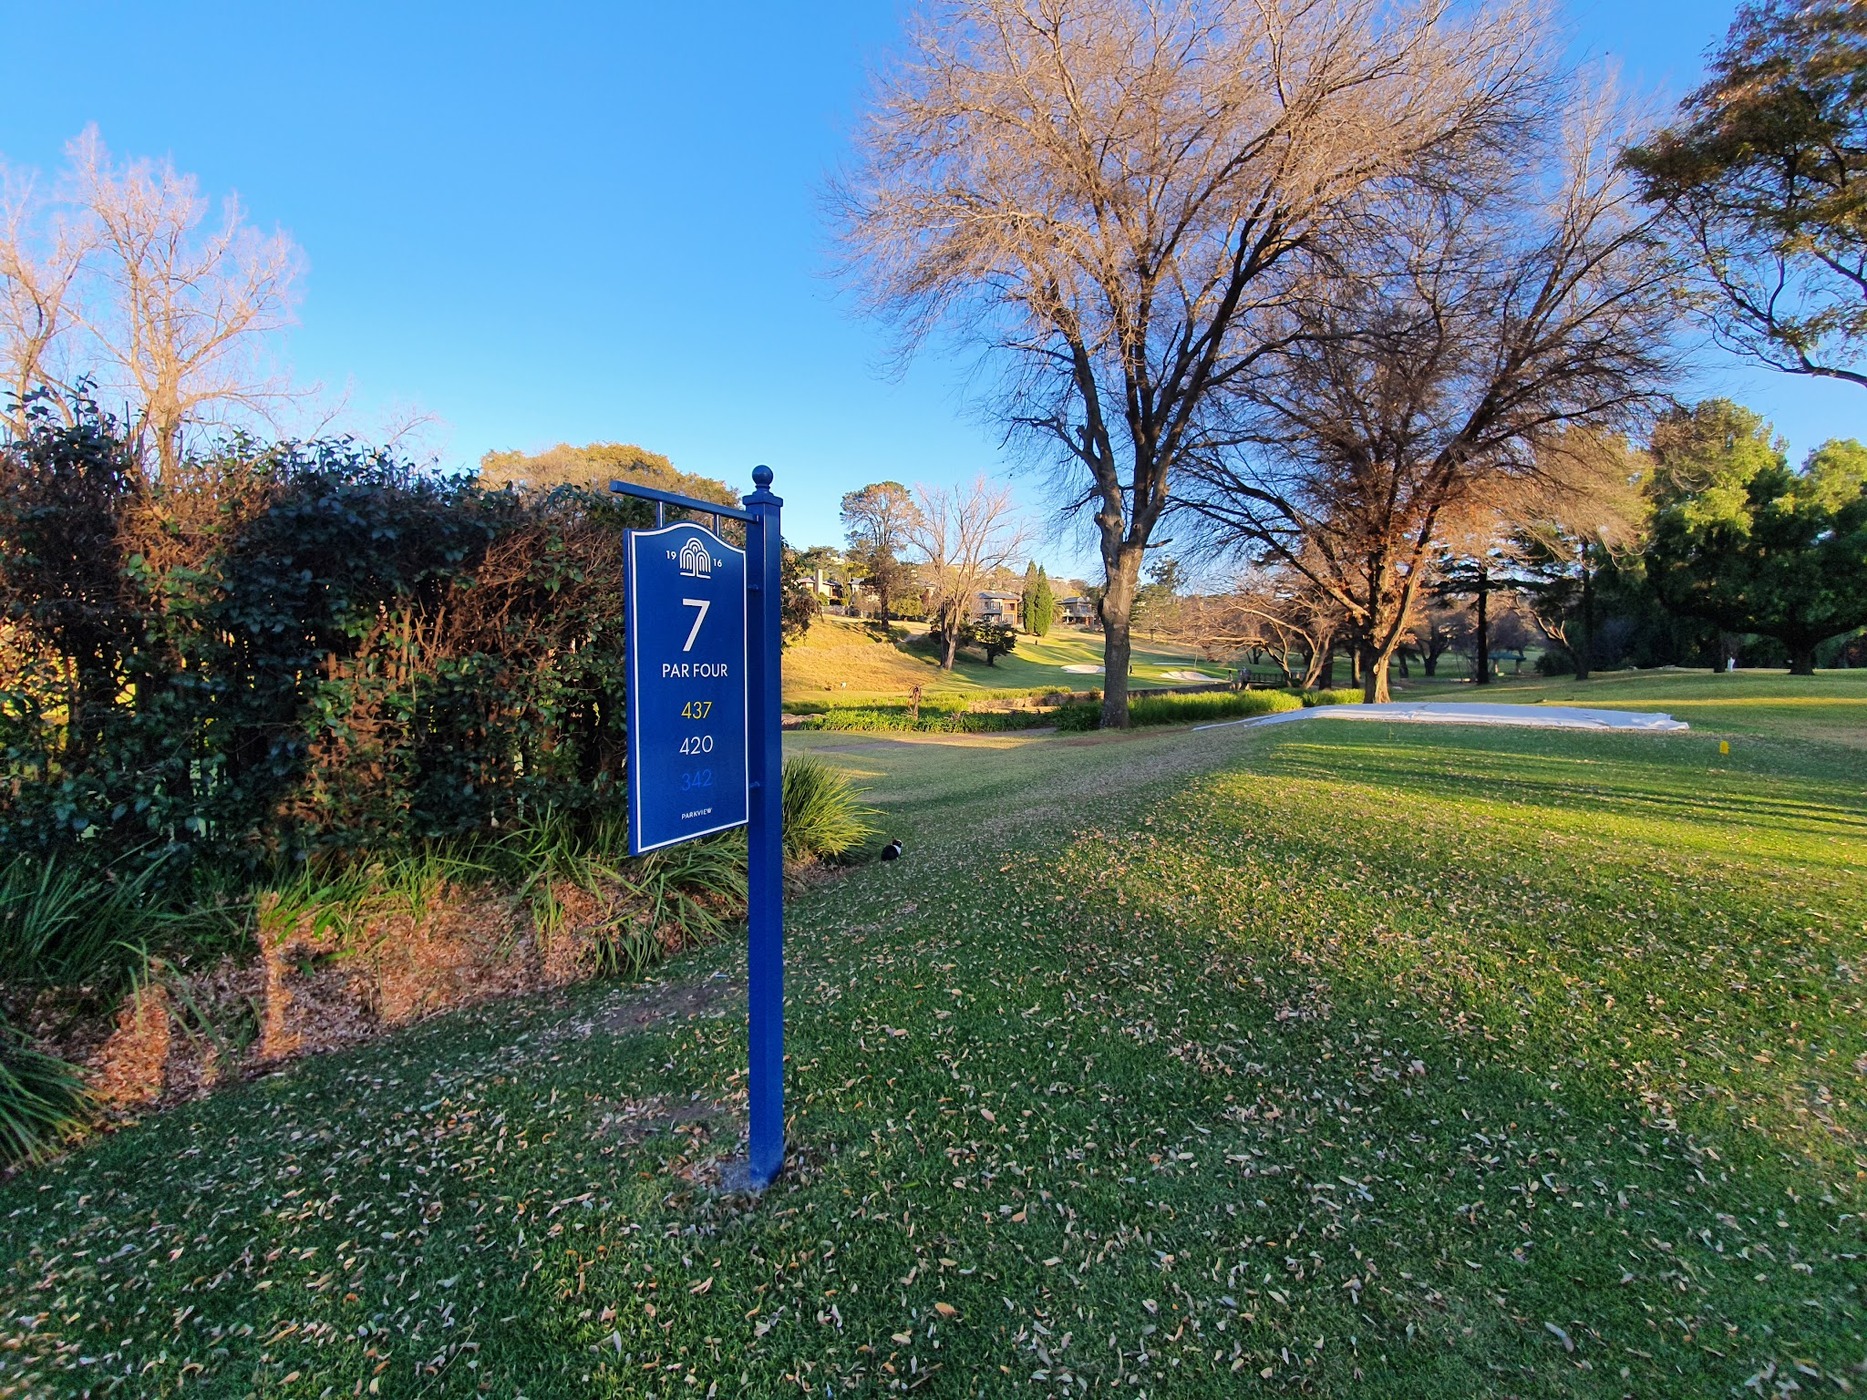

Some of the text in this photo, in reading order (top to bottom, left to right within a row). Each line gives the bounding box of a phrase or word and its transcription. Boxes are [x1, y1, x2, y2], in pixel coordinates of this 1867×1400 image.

[665, 550, 677, 560] 19
[713, 558, 723, 568] 16
[682, 598, 711, 652] 7
[662, 663, 728, 678] PAR FOUR
[681, 701, 713, 720] 437
[679, 735, 714, 755] 420
[681, 769, 713, 791] 342
[681, 807, 713, 820] PARKVIEW
